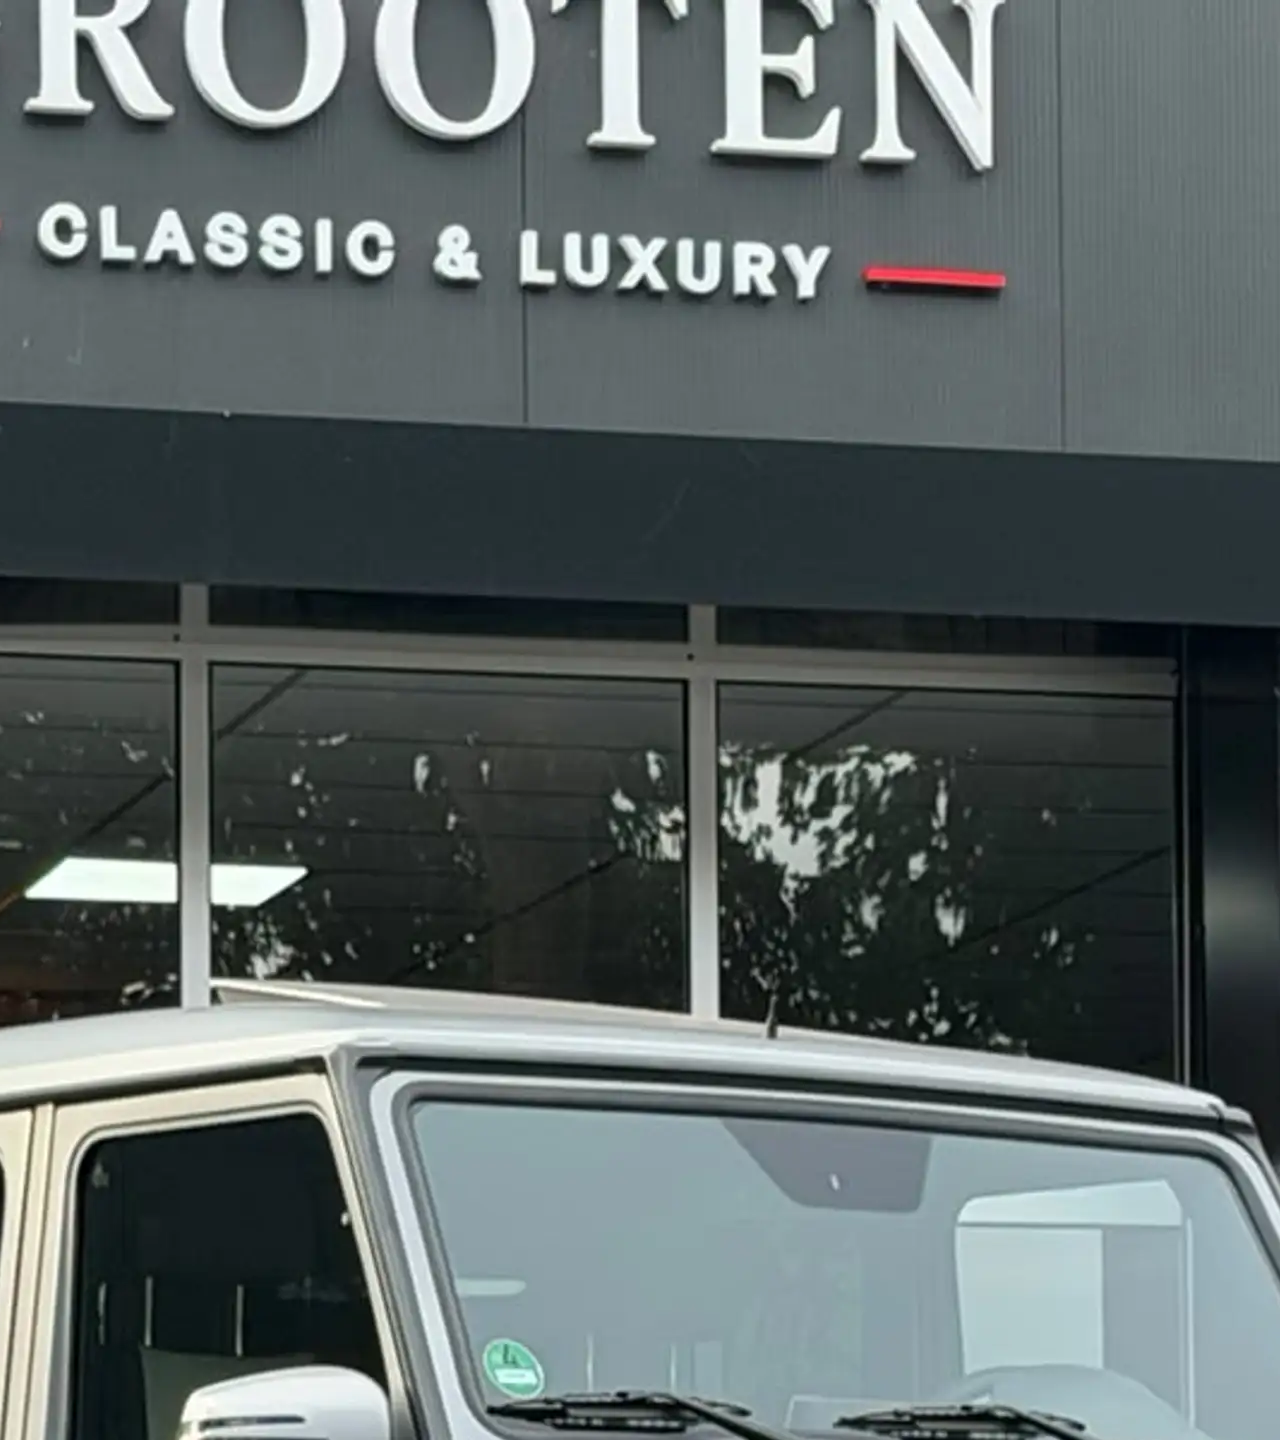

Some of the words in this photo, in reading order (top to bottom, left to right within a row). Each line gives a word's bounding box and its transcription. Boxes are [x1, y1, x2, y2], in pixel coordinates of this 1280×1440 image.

[37, 202, 396, 276] CLASSIC
[433, 224, 483, 282] &
[520, 229, 832, 300] LUXURY
